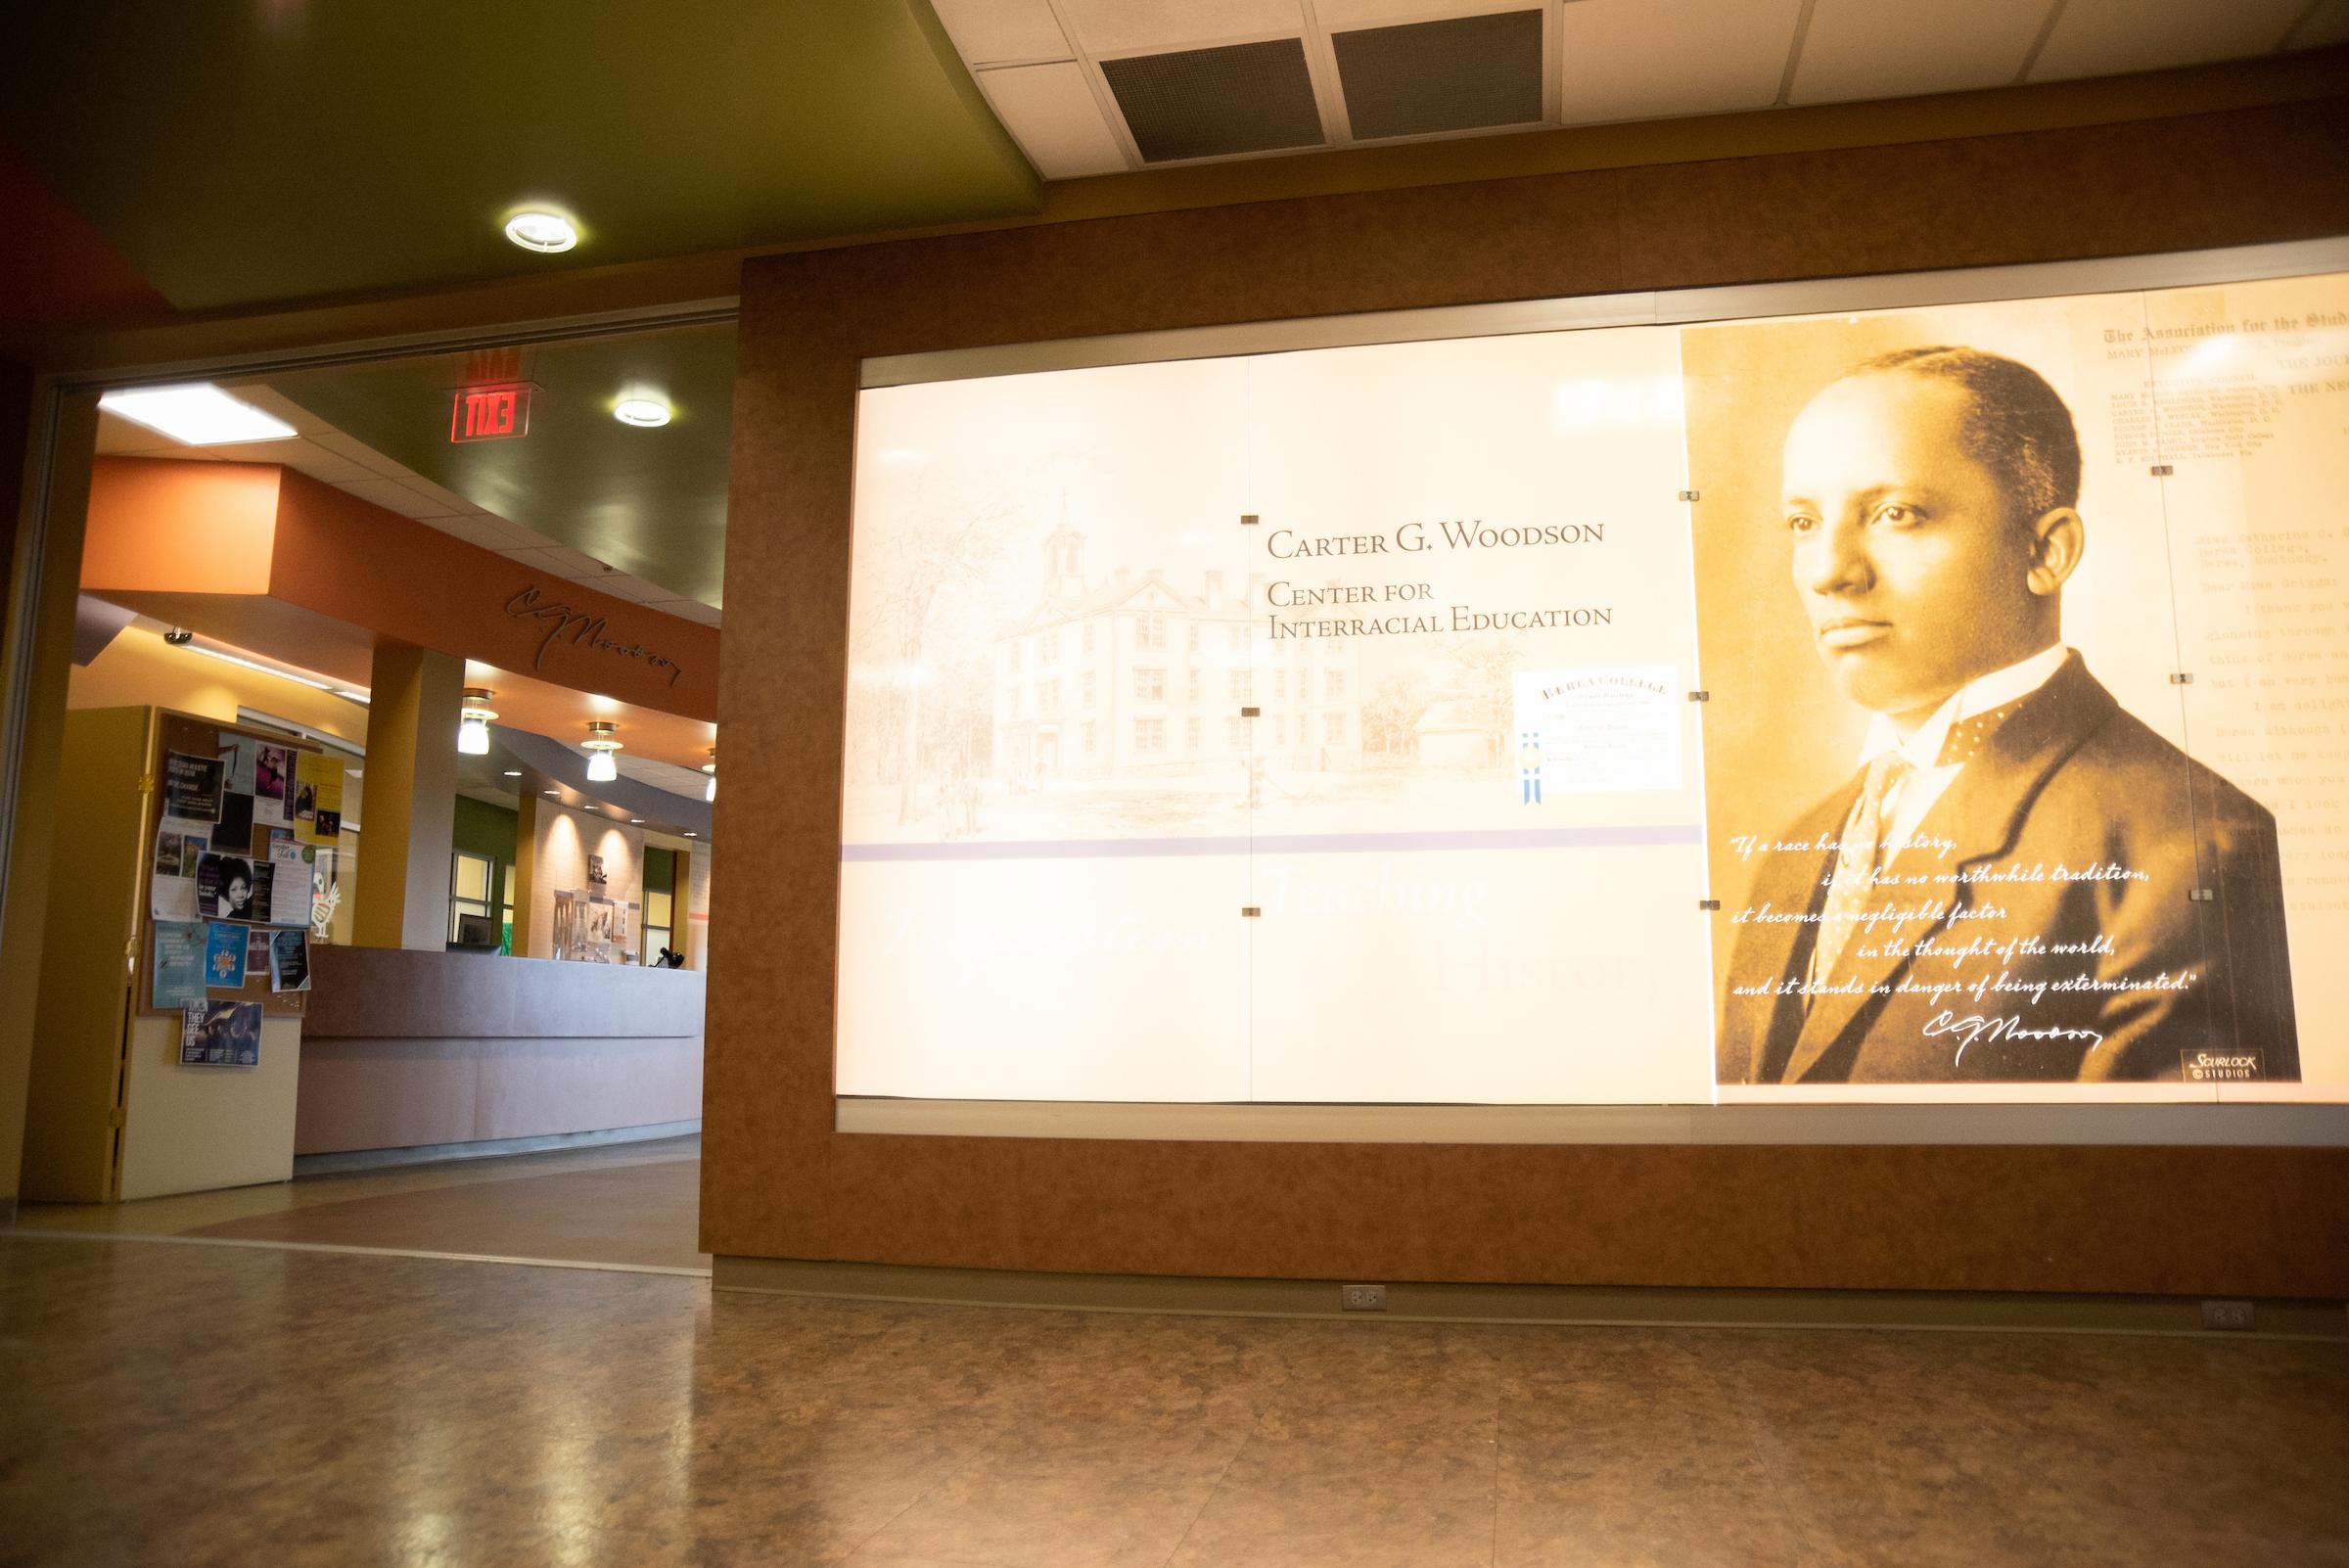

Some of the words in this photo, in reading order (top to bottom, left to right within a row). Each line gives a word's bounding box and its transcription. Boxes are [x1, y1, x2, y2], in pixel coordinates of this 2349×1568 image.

[2305, 310, 2349, 328] Stud
[1267, 530, 1389, 559] CARTER
[1396, 523, 1433, 552] G.
[1439, 520, 1605, 550] WOODSON
[1267, 580, 1378, 607] CENTER
[1384, 582, 1435, 602] FOR
[1268, 614, 1445, 640] INTERRACIAL
[1451, 605, 1613, 632] EDUCATION
[1758, 843, 1770, 852] a
[1773, 841, 1810, 852] race
[1878, 832, 1958, 859] hstory,
[1869, 866, 1901, 885] has
[1905, 875, 1928, 885] no
[1933, 862, 2045, 885] worthwhile
[2050, 861, 2150, 882] tradition,
[1730, 906, 1754, 924] it
[1754, 901, 1826, 923] becomes
[1847, 899, 1946, 934] negligible
[1948, 901, 2007, 929] factor
[1856, 945, 1878, 958] in
[1883, 938, 1911, 957] the
[1914, 937, 1998, 969] thought
[1996, 938, 2018, 965] of
[2019, 935, 2048, 956] the
[2050, 935, 2115, 956] world,
[1732, 976, 1774, 995] and
[1774, 977, 1801, 995] it
[1797, 976, 1865, 994] stands
[1868, 982, 1892, 994] in
[1895, 974, 1962, 1006] danger
[1967, 975, 1991, 1002] of
[1991, 971, 2048, 1004] being
[2050, 971, 2197, 992] exterminated."
[2188, 1053, 2257, 1071] SCURLOCK
[2205, 1070, 2250, 1079] STUDIOS
